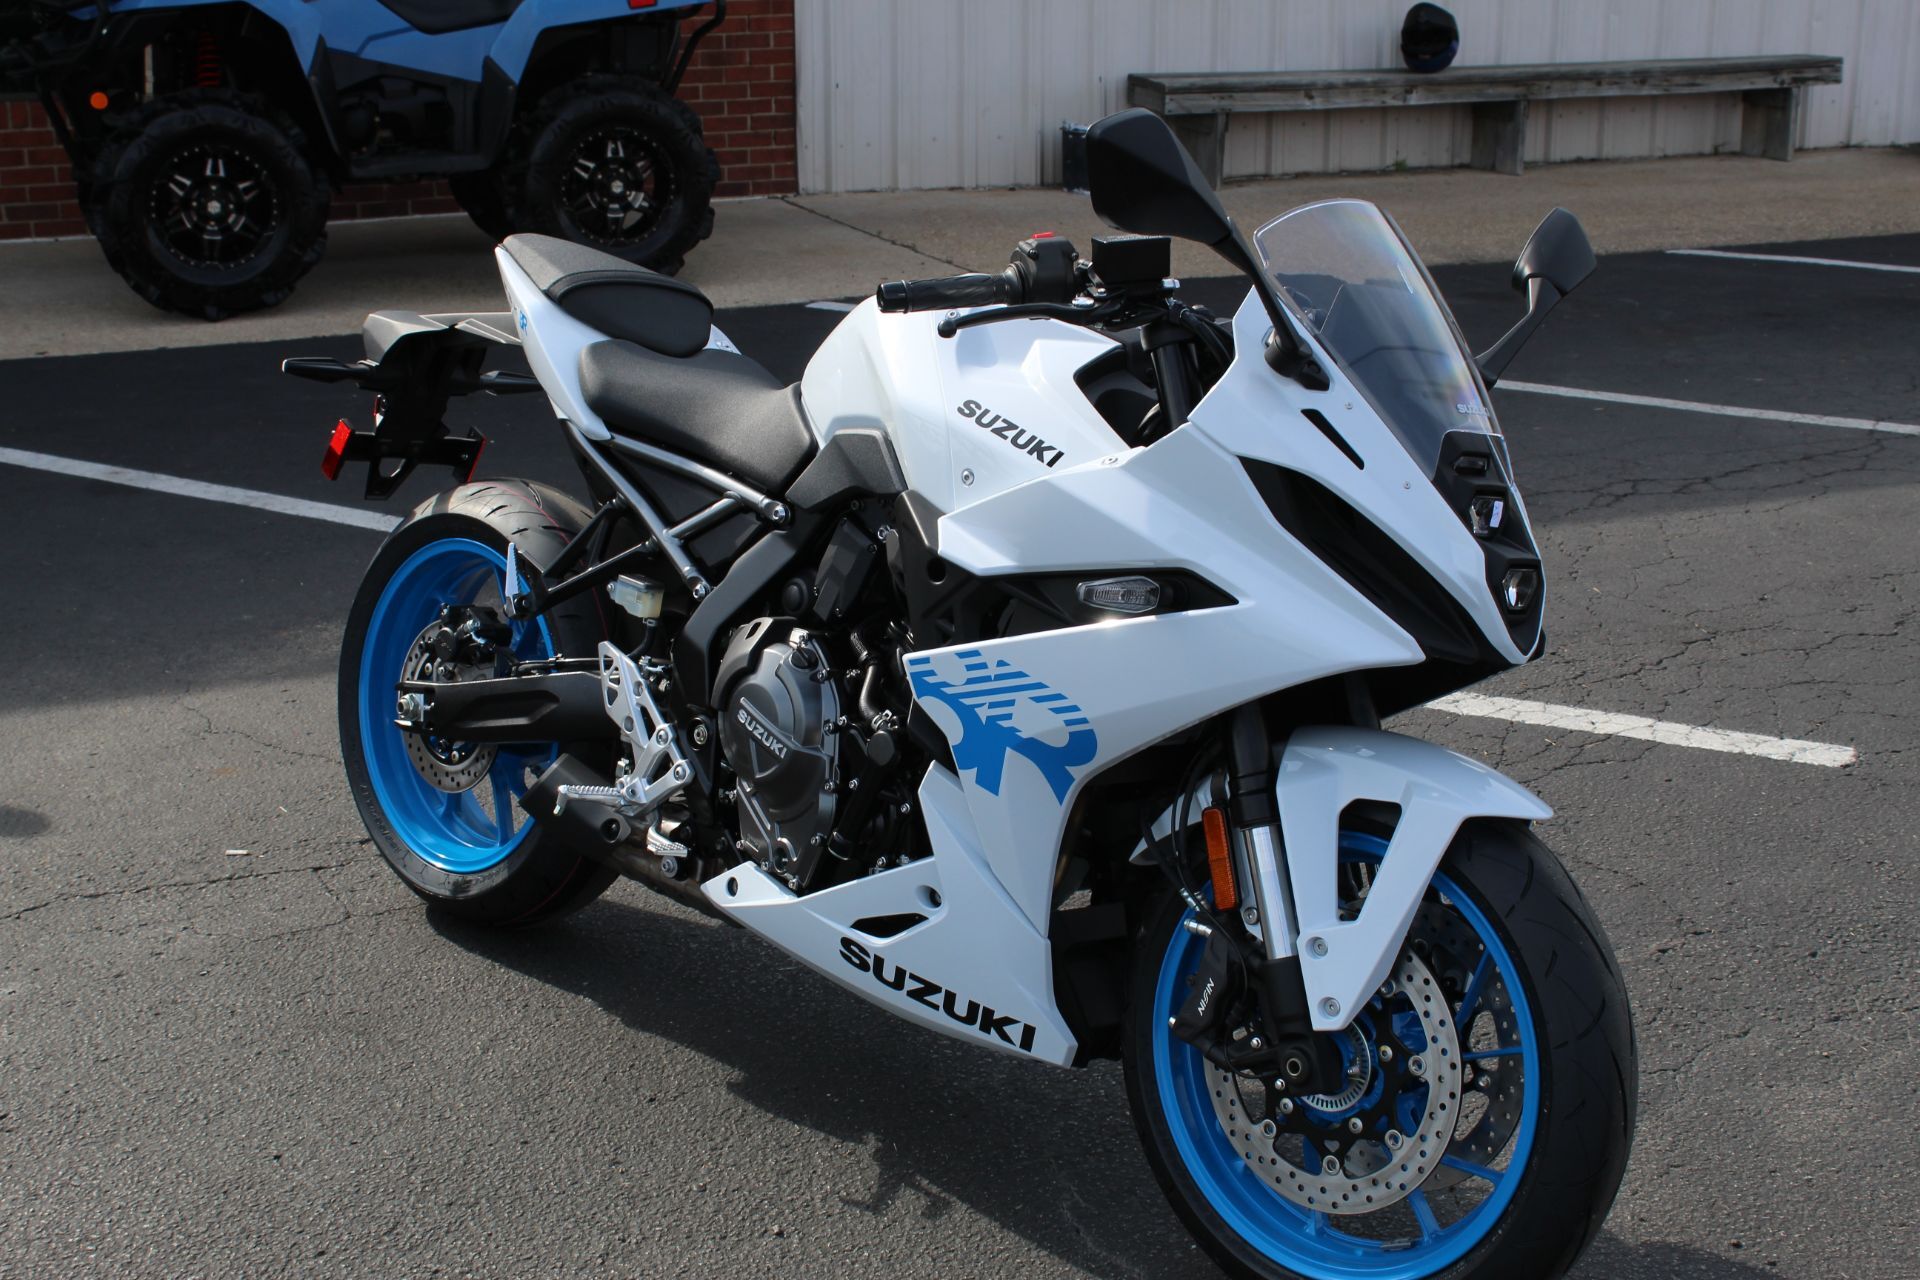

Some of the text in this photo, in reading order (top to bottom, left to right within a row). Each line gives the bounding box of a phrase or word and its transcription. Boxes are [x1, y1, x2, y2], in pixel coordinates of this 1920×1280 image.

[957, 399, 1065, 468] SUZUKI
[737, 709, 787, 759] SUZUKI
[839, 936, 1037, 1053] SUZUKI
[1197, 977, 1215, 1016] NISSIN
